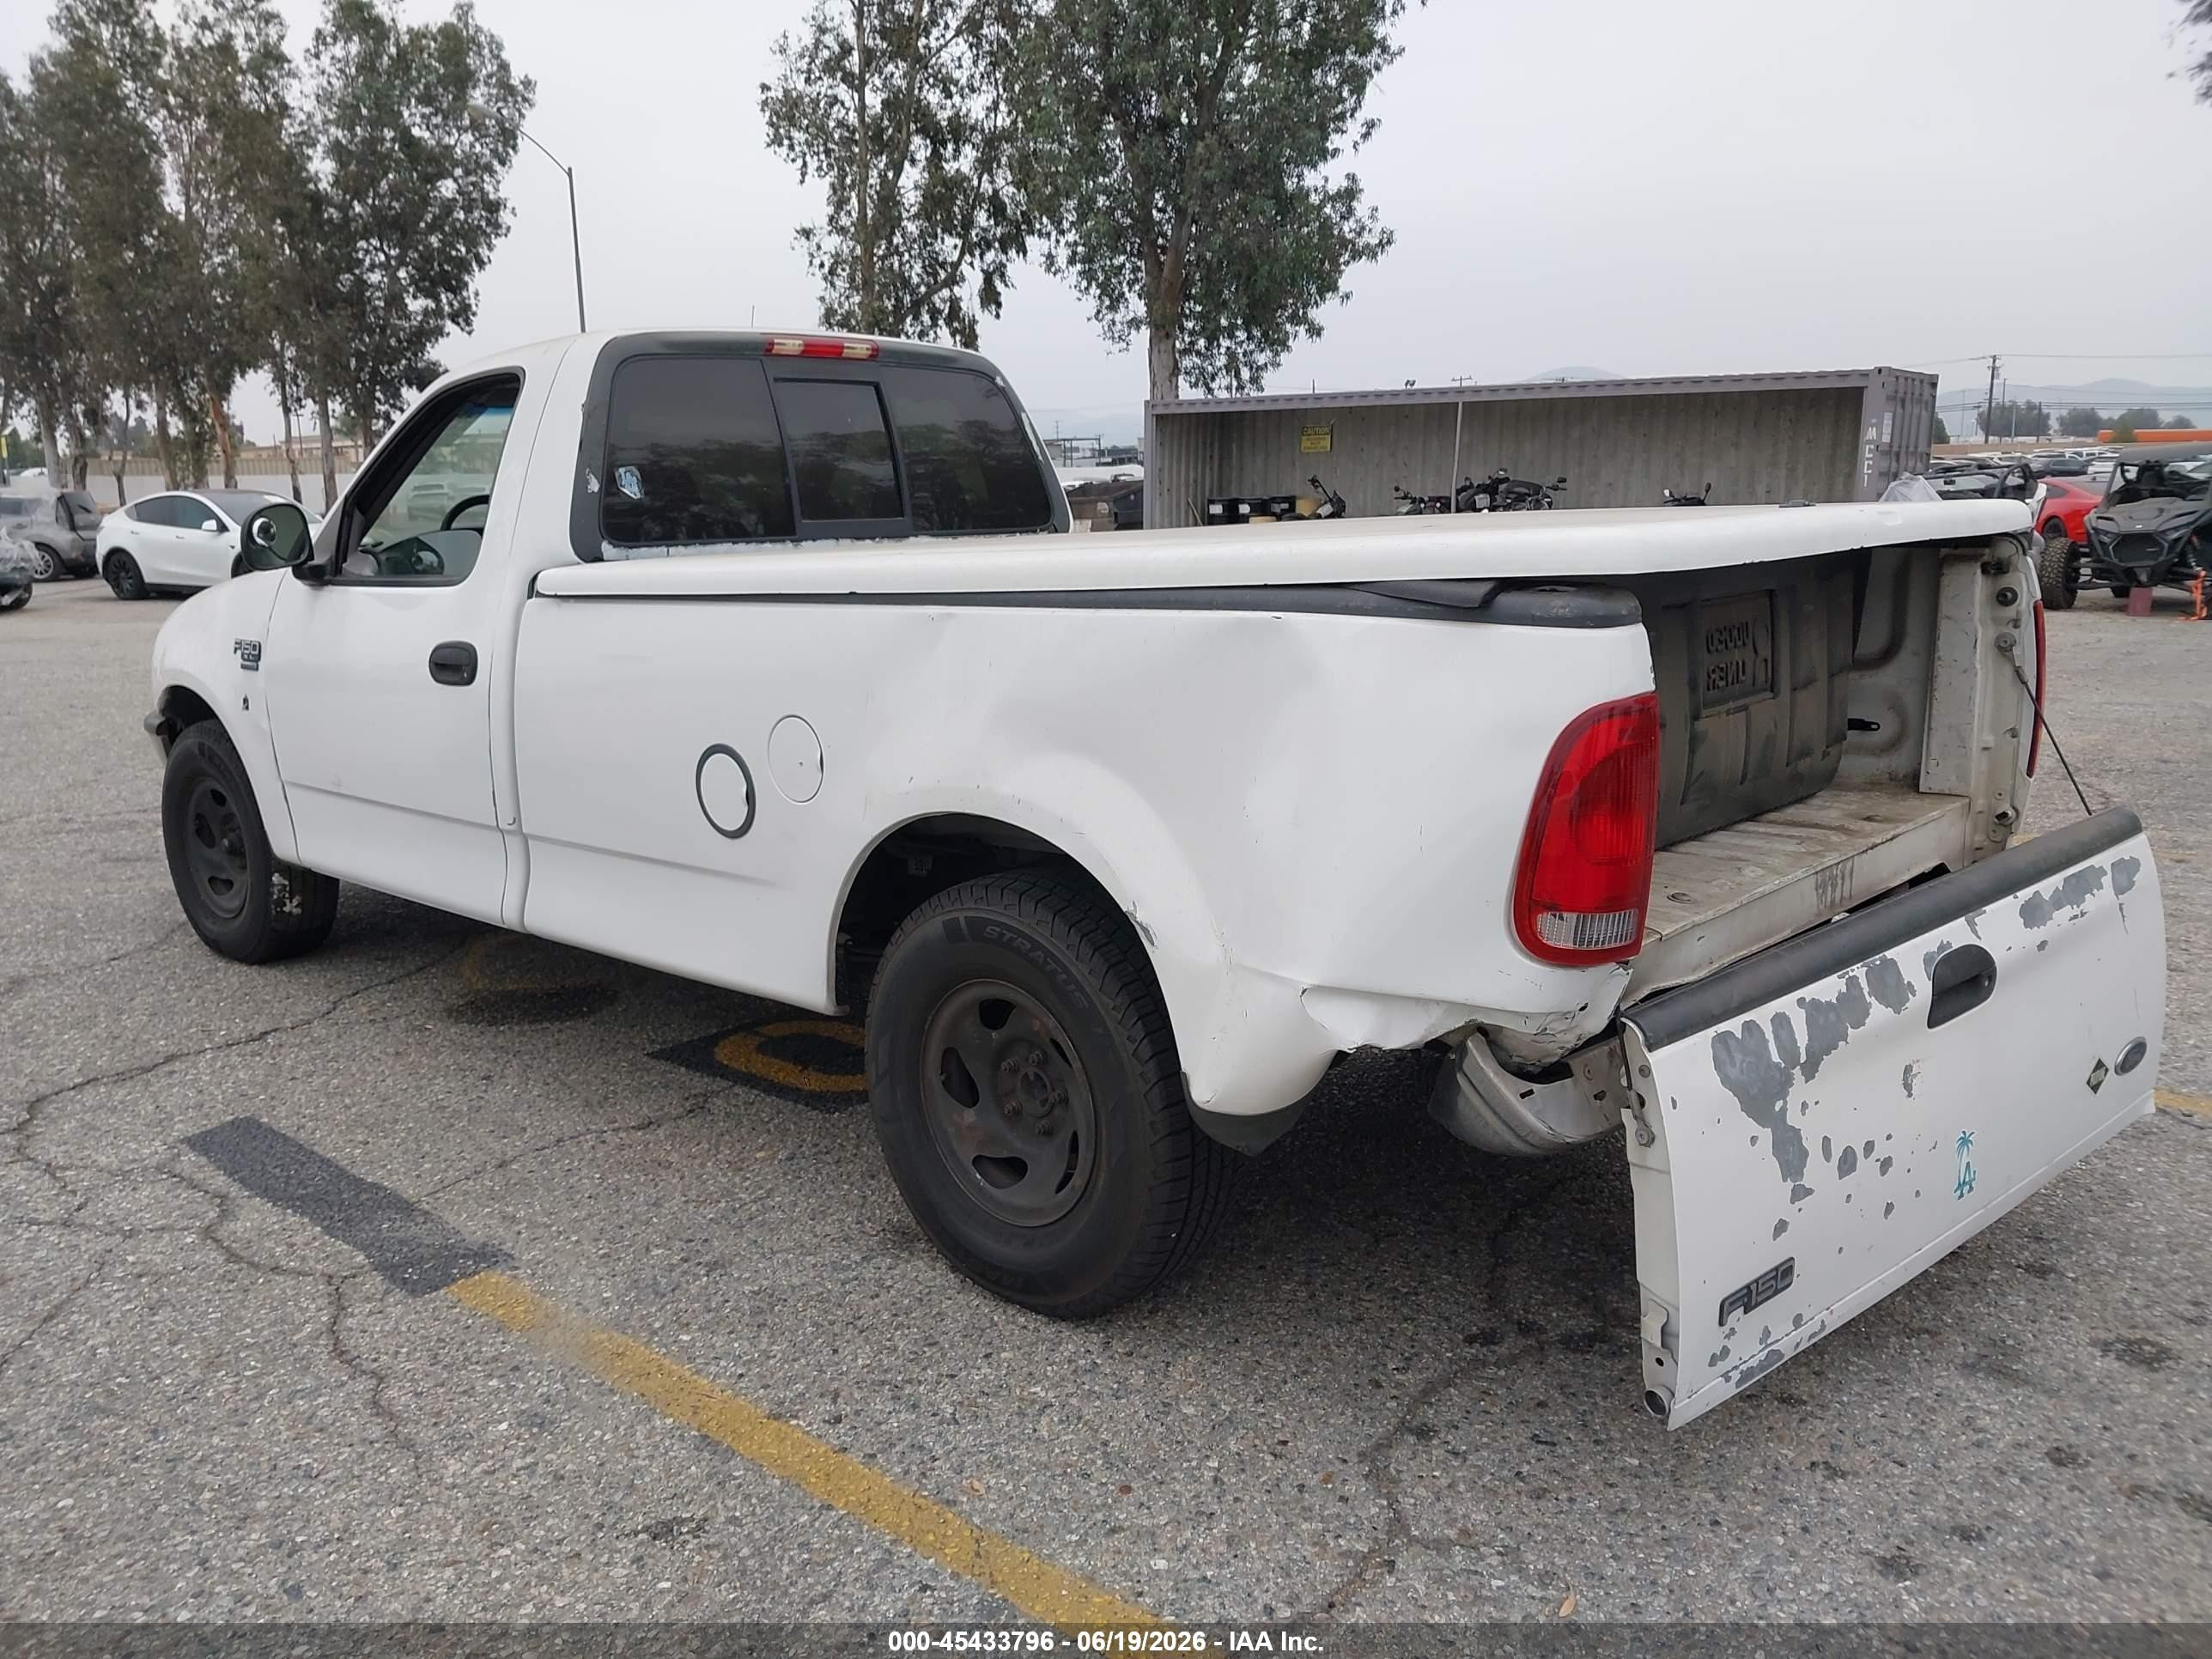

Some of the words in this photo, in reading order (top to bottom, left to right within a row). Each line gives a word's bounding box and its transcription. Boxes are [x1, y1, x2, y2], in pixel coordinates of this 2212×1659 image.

[1302, 425, 1330, 435] CAUTION
[234, 638, 262, 655] F150
[983, 925, 1089, 1008] STRATUS
[1719, 1256, 1796, 1327] F150
